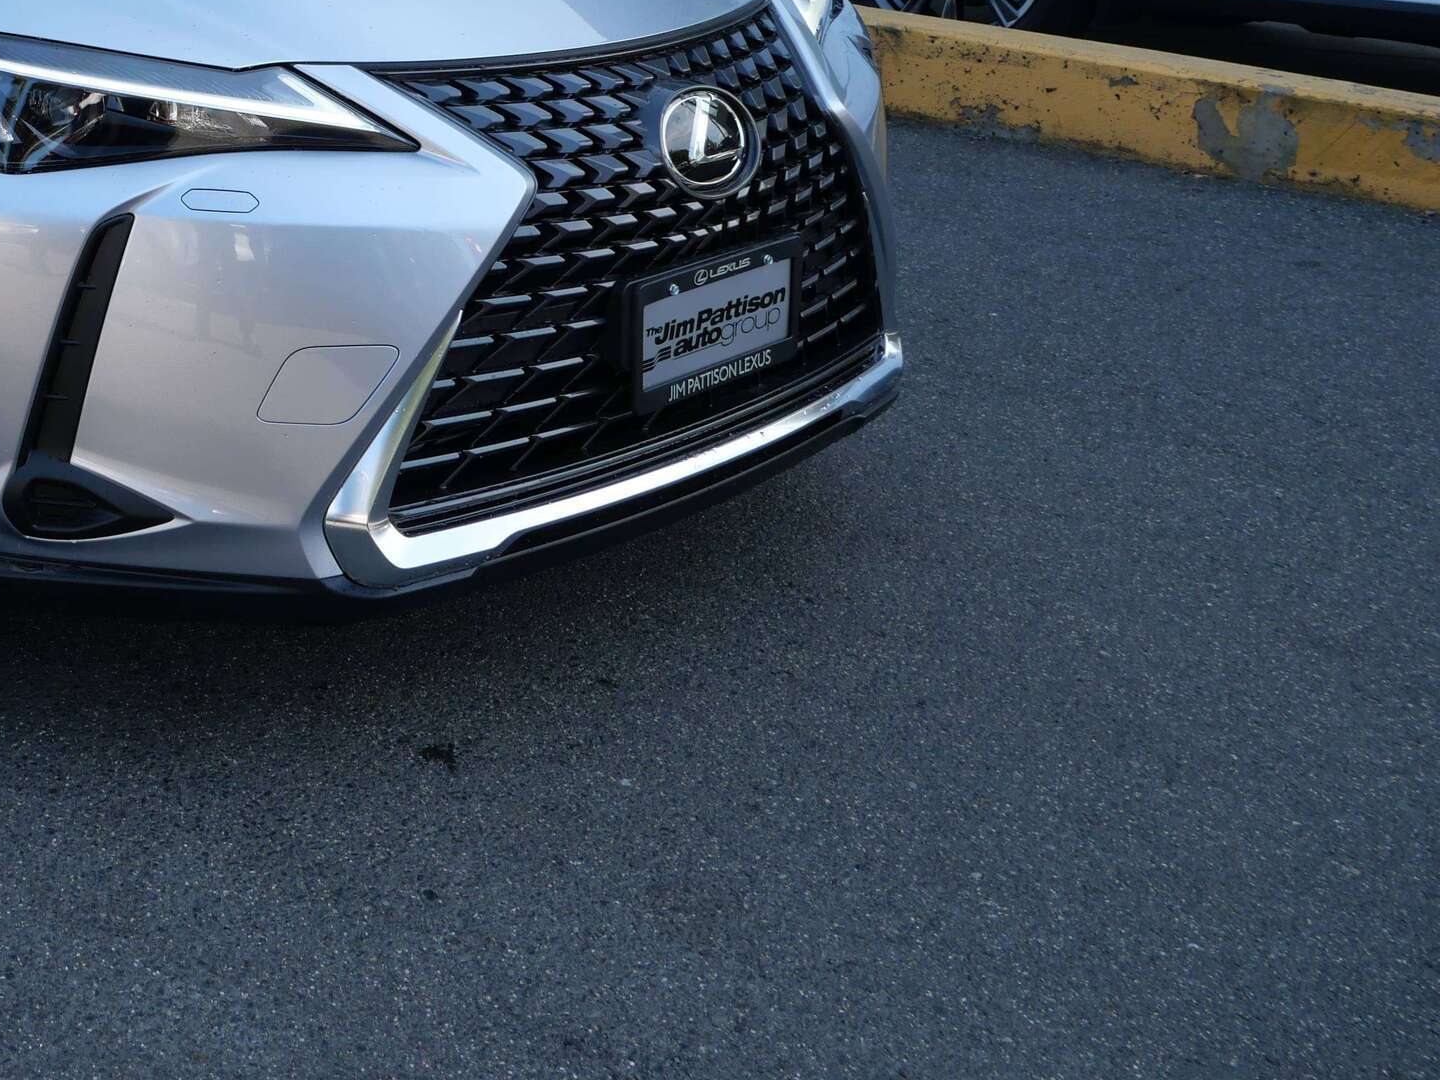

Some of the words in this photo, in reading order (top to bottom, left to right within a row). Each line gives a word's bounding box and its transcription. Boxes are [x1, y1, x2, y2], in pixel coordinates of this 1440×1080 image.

[710, 257, 751, 277] LEXUS
[646, 325, 663, 337] The
[655, 317, 694, 345] Jim
[696, 287, 786, 331] Pattison
[668, 381, 686, 402] JIM
[687, 362, 737, 394] PATTISON
[739, 349, 772, 375] LEXUS
